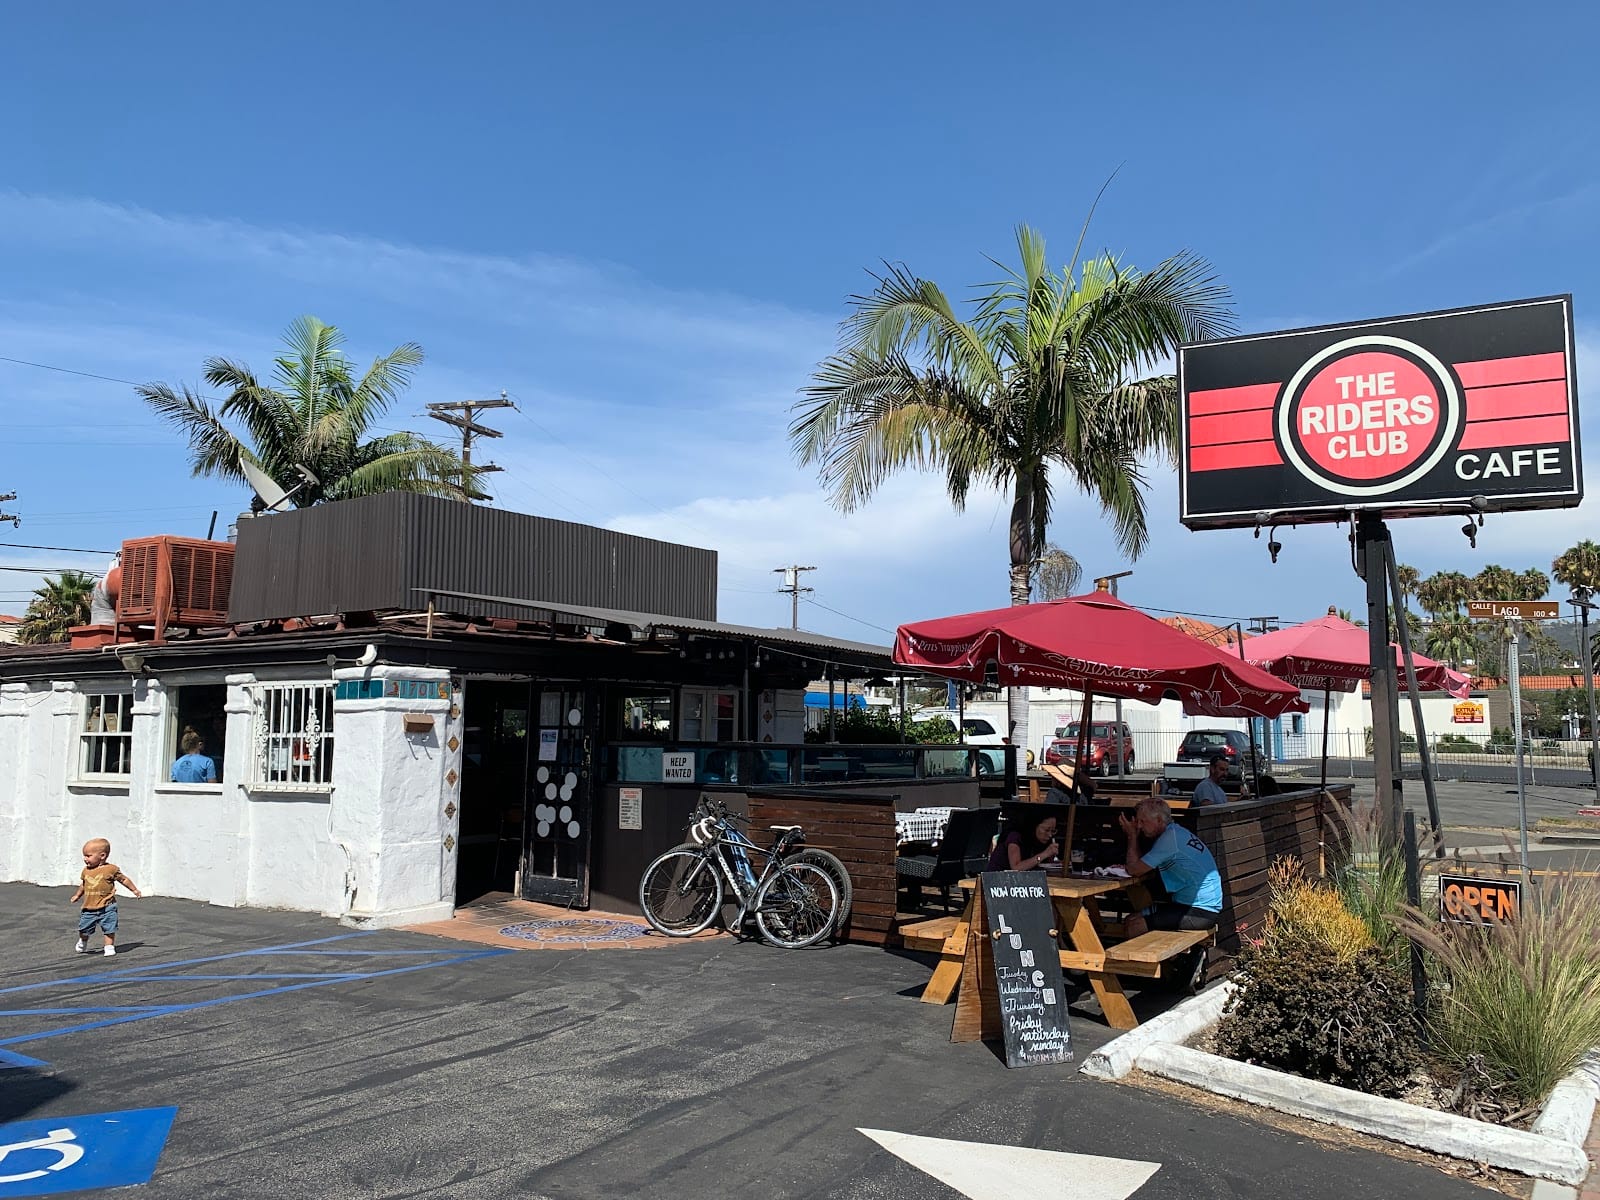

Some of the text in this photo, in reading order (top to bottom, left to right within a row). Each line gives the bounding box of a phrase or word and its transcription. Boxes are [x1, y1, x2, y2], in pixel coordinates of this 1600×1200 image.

[1335, 371, 1396, 399] THE
[1301, 395, 1435, 435] RIDERS
[1327, 430, 1409, 460] CLUB
[1455, 447, 1562, 481] CAFE
[1492, 604, 1520, 616] LAGO
[1041, 652, 1165, 679] CHIMAY
[401, 682, 434, 697] 1701
[665, 768, 692, 778] WANTED
[670, 757, 687, 767] HELP
[990, 886, 1046, 898] NOW OPEN FOR
[1445, 883, 1516, 920] OPEN
